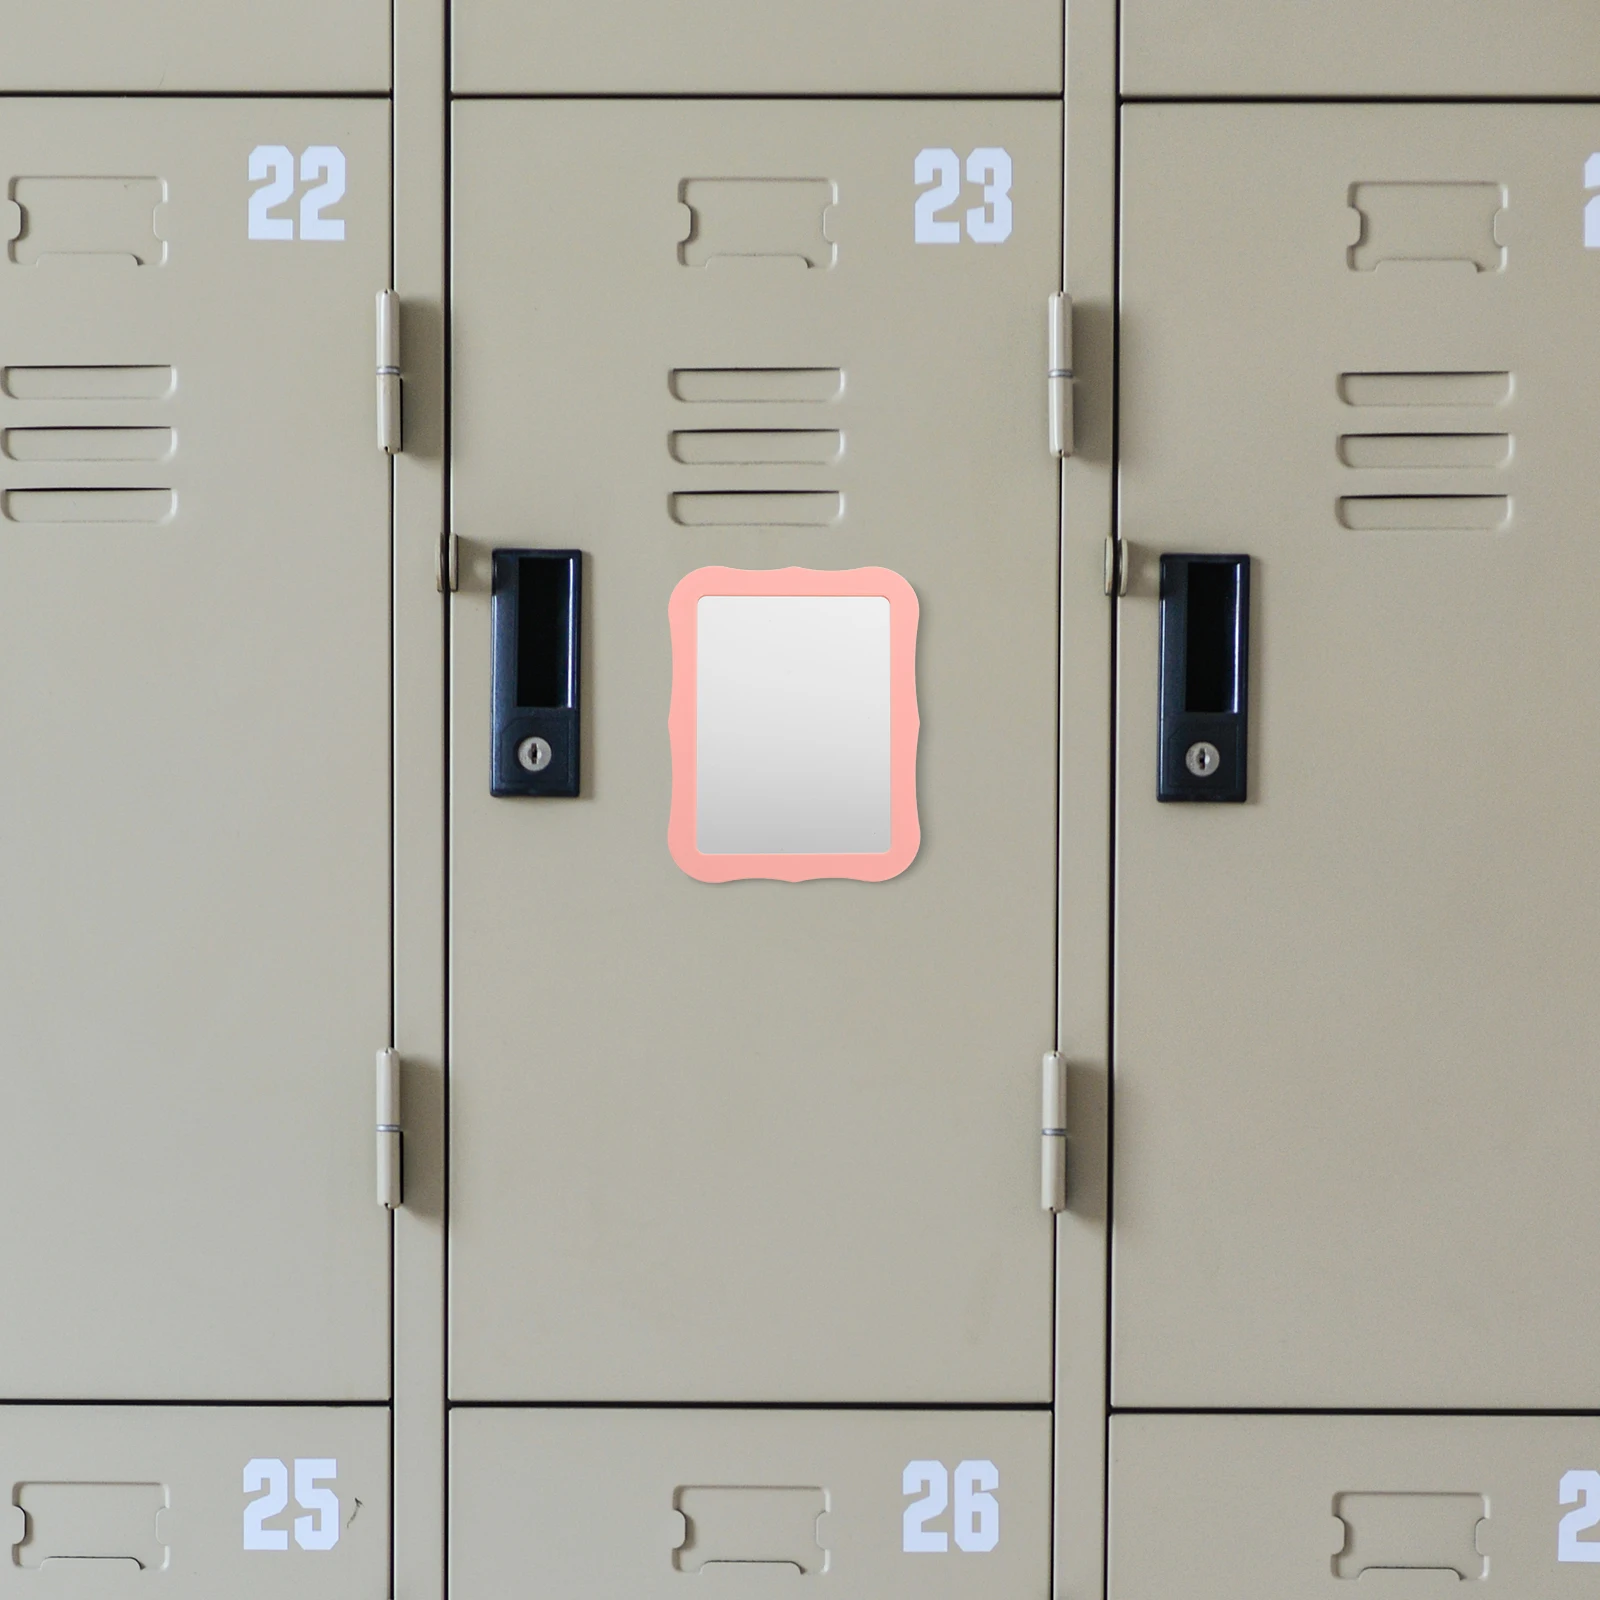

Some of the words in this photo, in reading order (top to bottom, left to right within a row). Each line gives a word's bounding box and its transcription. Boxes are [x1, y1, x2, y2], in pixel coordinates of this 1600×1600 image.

[248, 145, 347, 241] 22
[914, 147, 1012, 244] 23
[243, 1458, 341, 1551] 25
[903, 1460, 999, 1552] 26
[1558, 1470, 1600, 1562] 2
